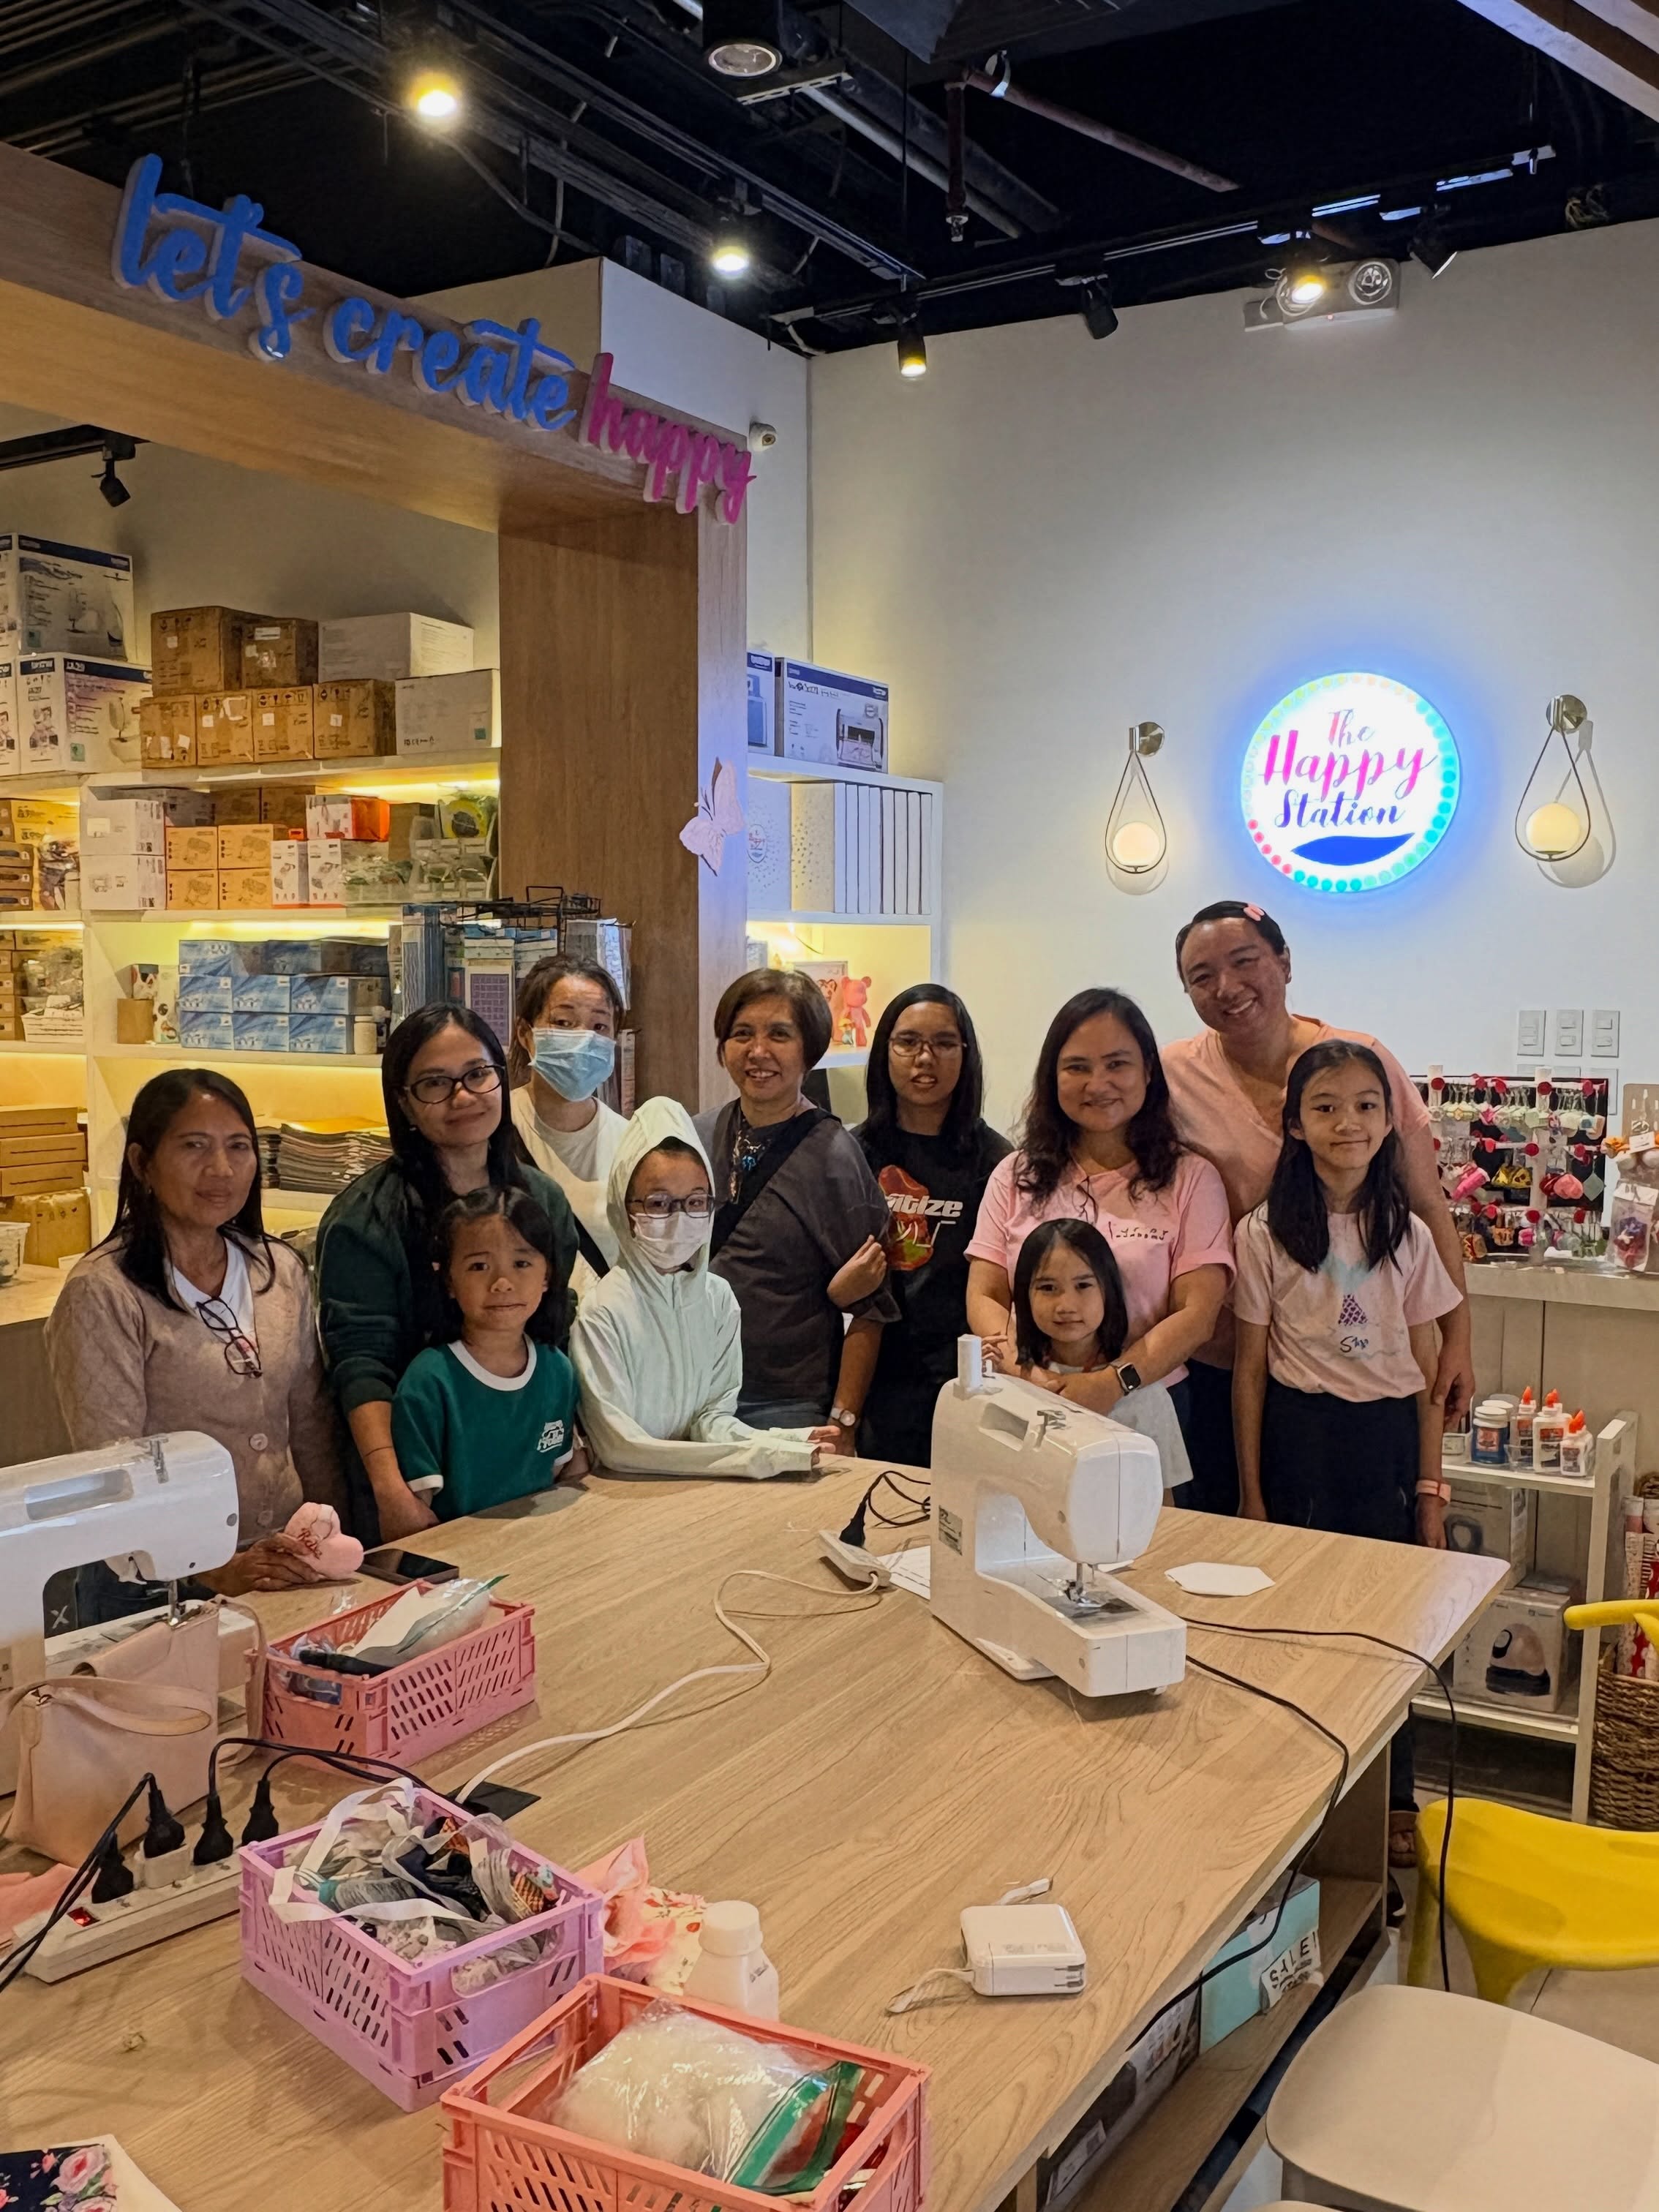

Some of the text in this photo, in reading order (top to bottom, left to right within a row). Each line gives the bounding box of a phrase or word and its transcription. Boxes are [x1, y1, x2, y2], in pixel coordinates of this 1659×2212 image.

[325, 297, 578, 432] create
[581, 353, 758, 525] happy
[1328, 708, 1377, 748] The
[1258, 729, 1439, 802] Happy
[1274, 789, 1406, 828] Station
